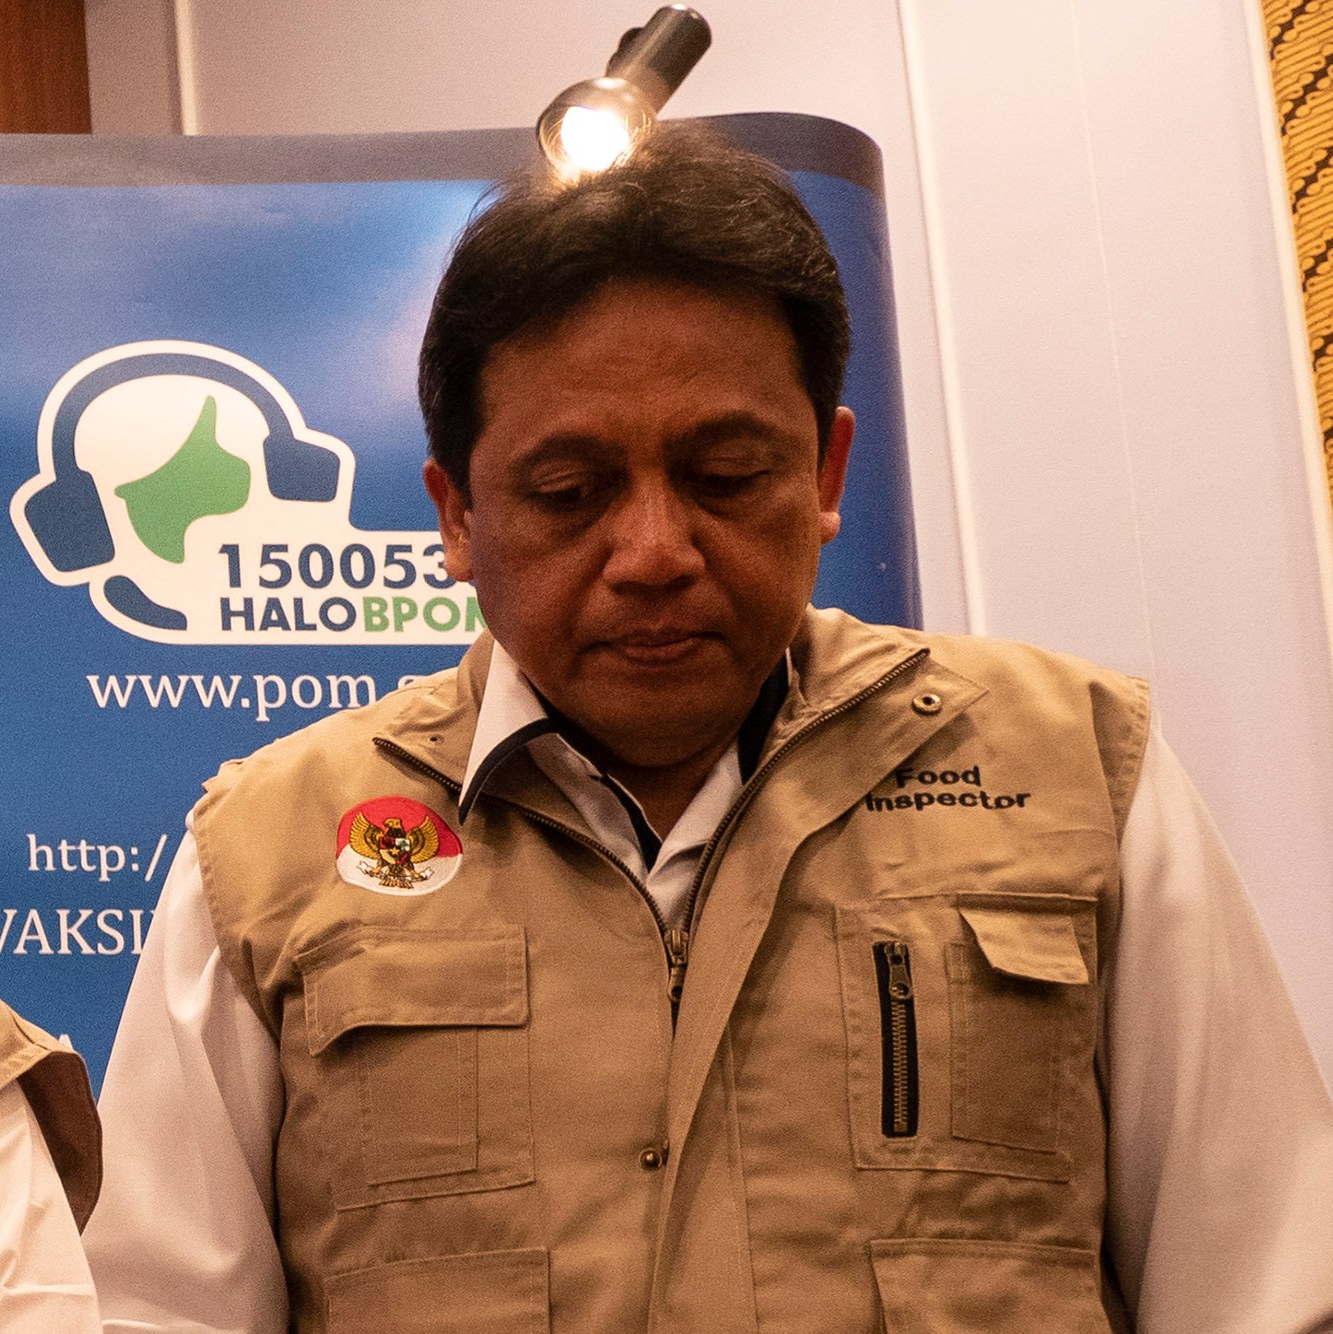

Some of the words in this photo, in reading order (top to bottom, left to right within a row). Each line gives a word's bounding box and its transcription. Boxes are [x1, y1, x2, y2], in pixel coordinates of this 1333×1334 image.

[219, 543, 476, 589] 150053
[86, 674, 417, 722] www.pom
[895, 765, 981, 788] Food
[864, 790, 1031, 812] Inspector
